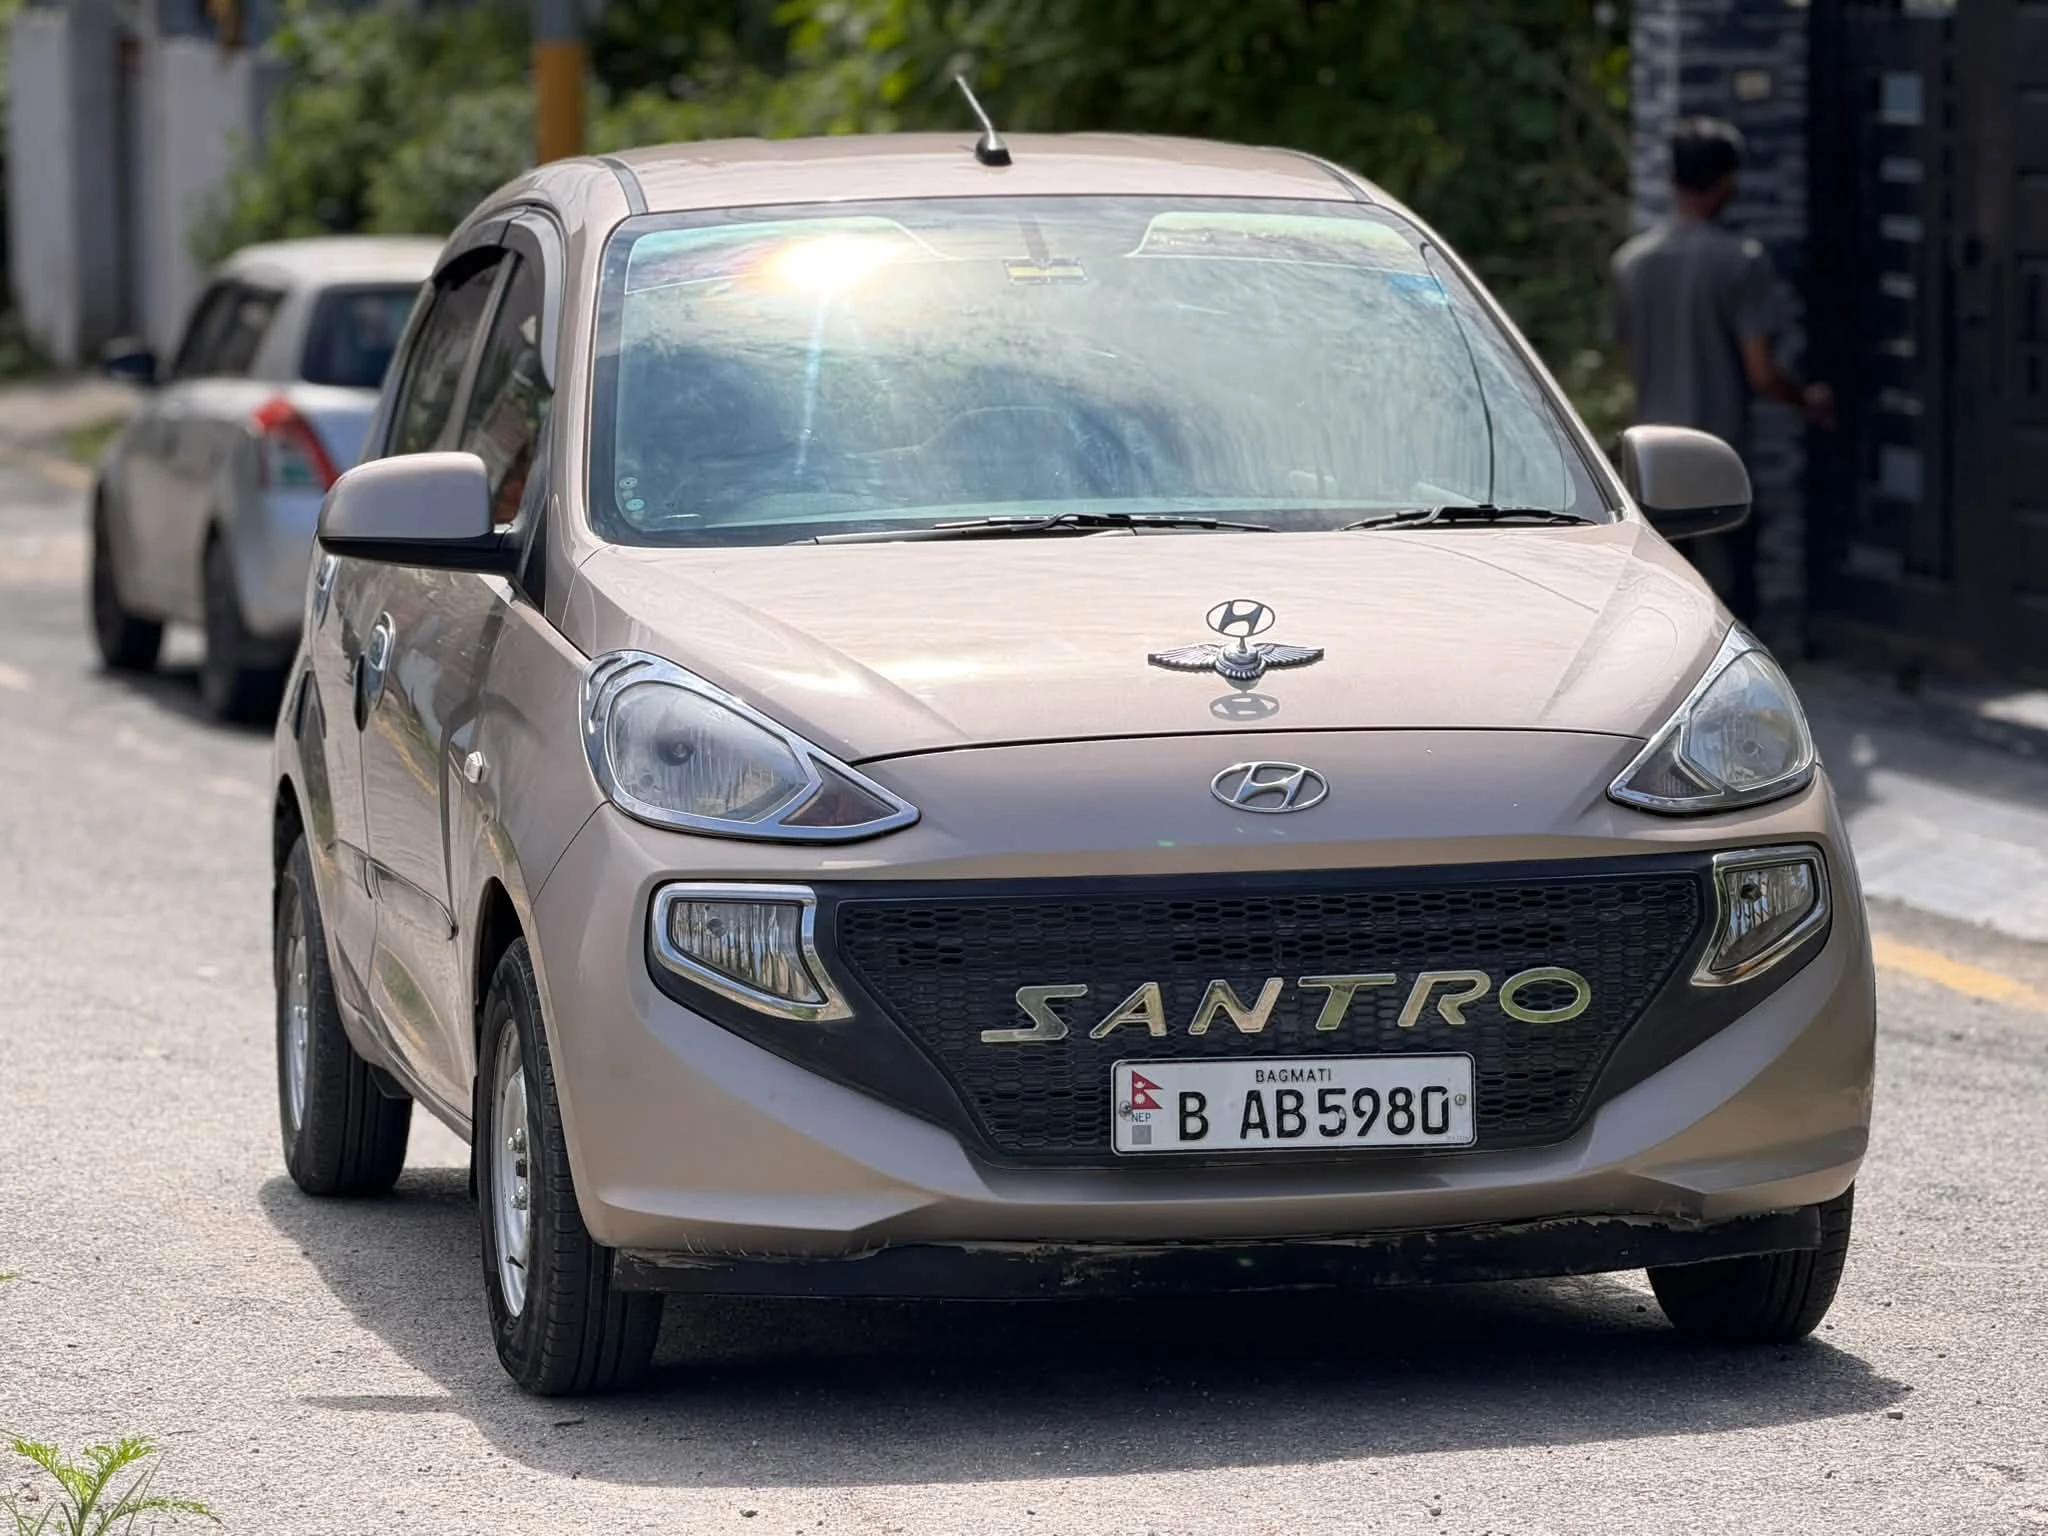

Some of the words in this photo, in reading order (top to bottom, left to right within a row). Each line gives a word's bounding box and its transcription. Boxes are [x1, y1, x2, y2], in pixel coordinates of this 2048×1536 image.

[981, 966, 1592, 1043] SANTRO
[1255, 1067, 1332, 1083] BAGMATI
[1131, 1111, 1152, 1123] NEP
[1179, 1091, 1209, 1141] B
